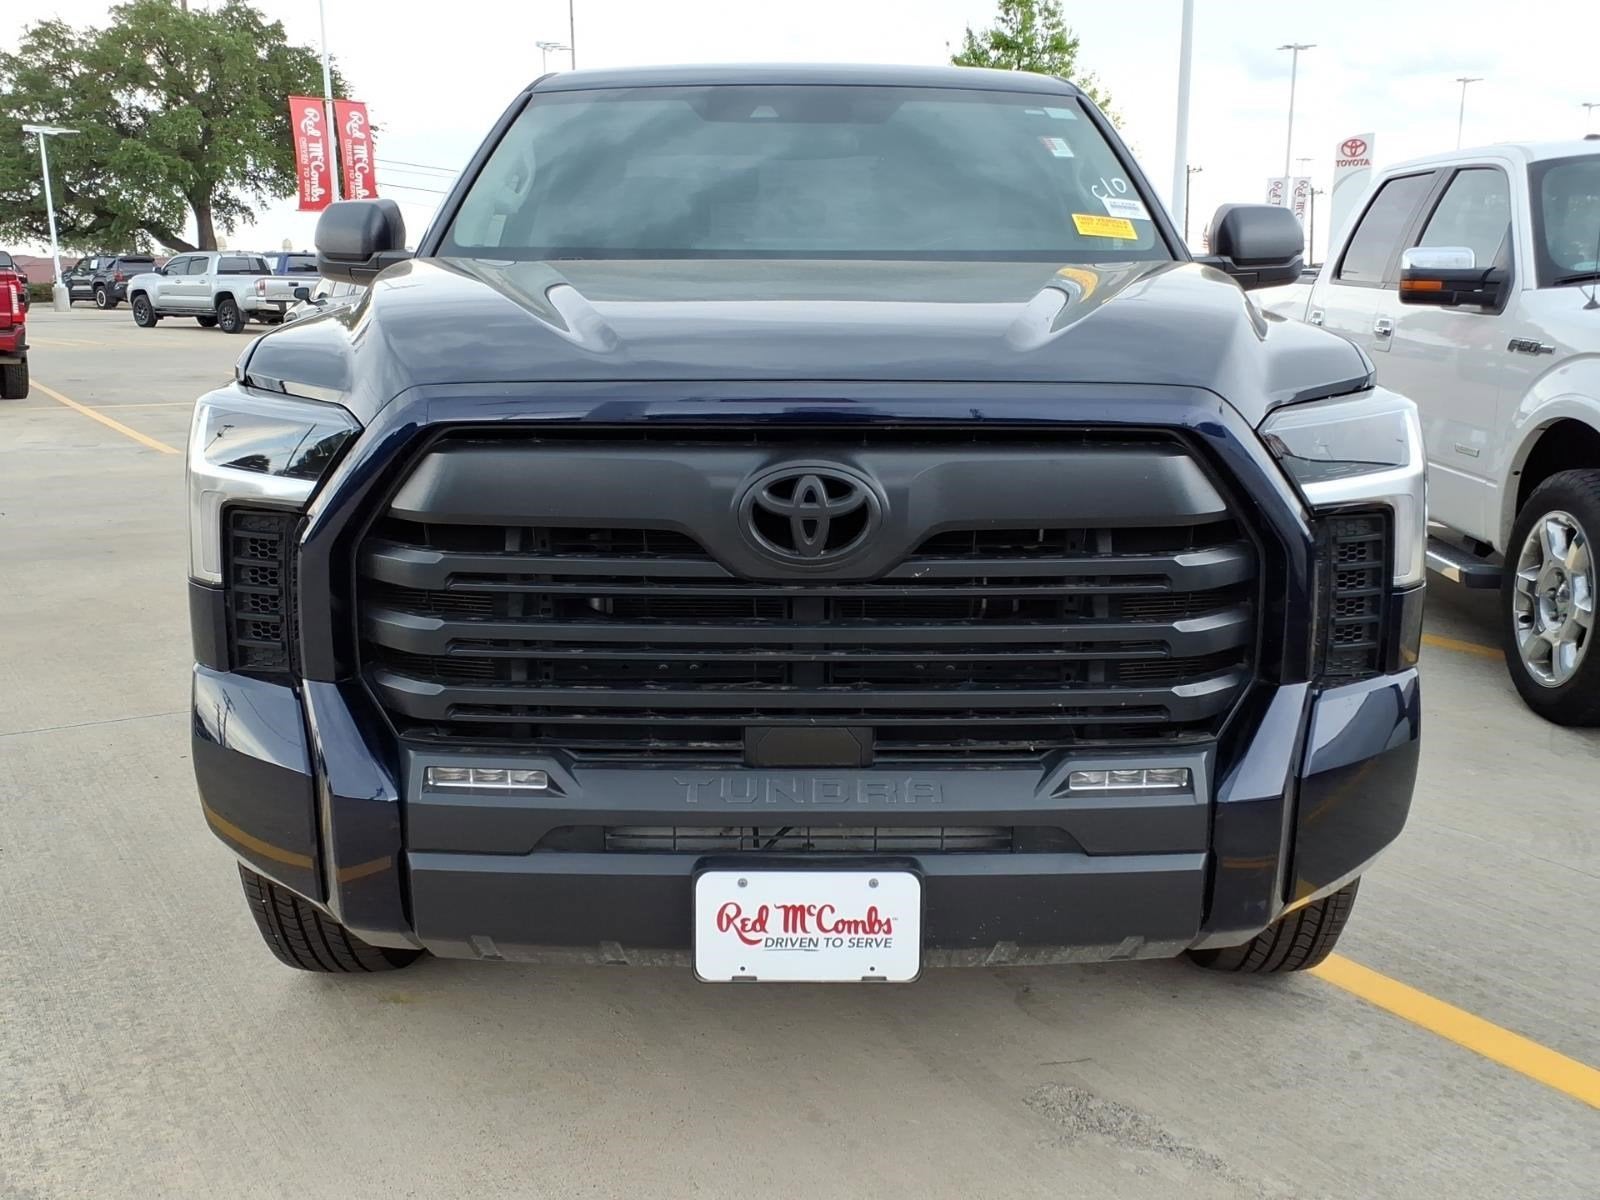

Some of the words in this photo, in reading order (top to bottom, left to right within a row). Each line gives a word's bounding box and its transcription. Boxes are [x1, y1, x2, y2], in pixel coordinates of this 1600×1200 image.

[301, 107, 321, 136] Red
[346, 111, 366, 139] Red
[303, 168, 310, 178] TO
[308, 138, 326, 202] McCombs
[1335, 159, 1370, 168] TOYOTA
[673, 776, 944, 804] TUNDRA
[716, 902, 769, 946] Red
[774, 904, 893, 936] McCombs
[764, 937, 819, 949] DRIVEN
[823, 937, 844, 949] TO
[847, 937, 893, 949] SERVE
